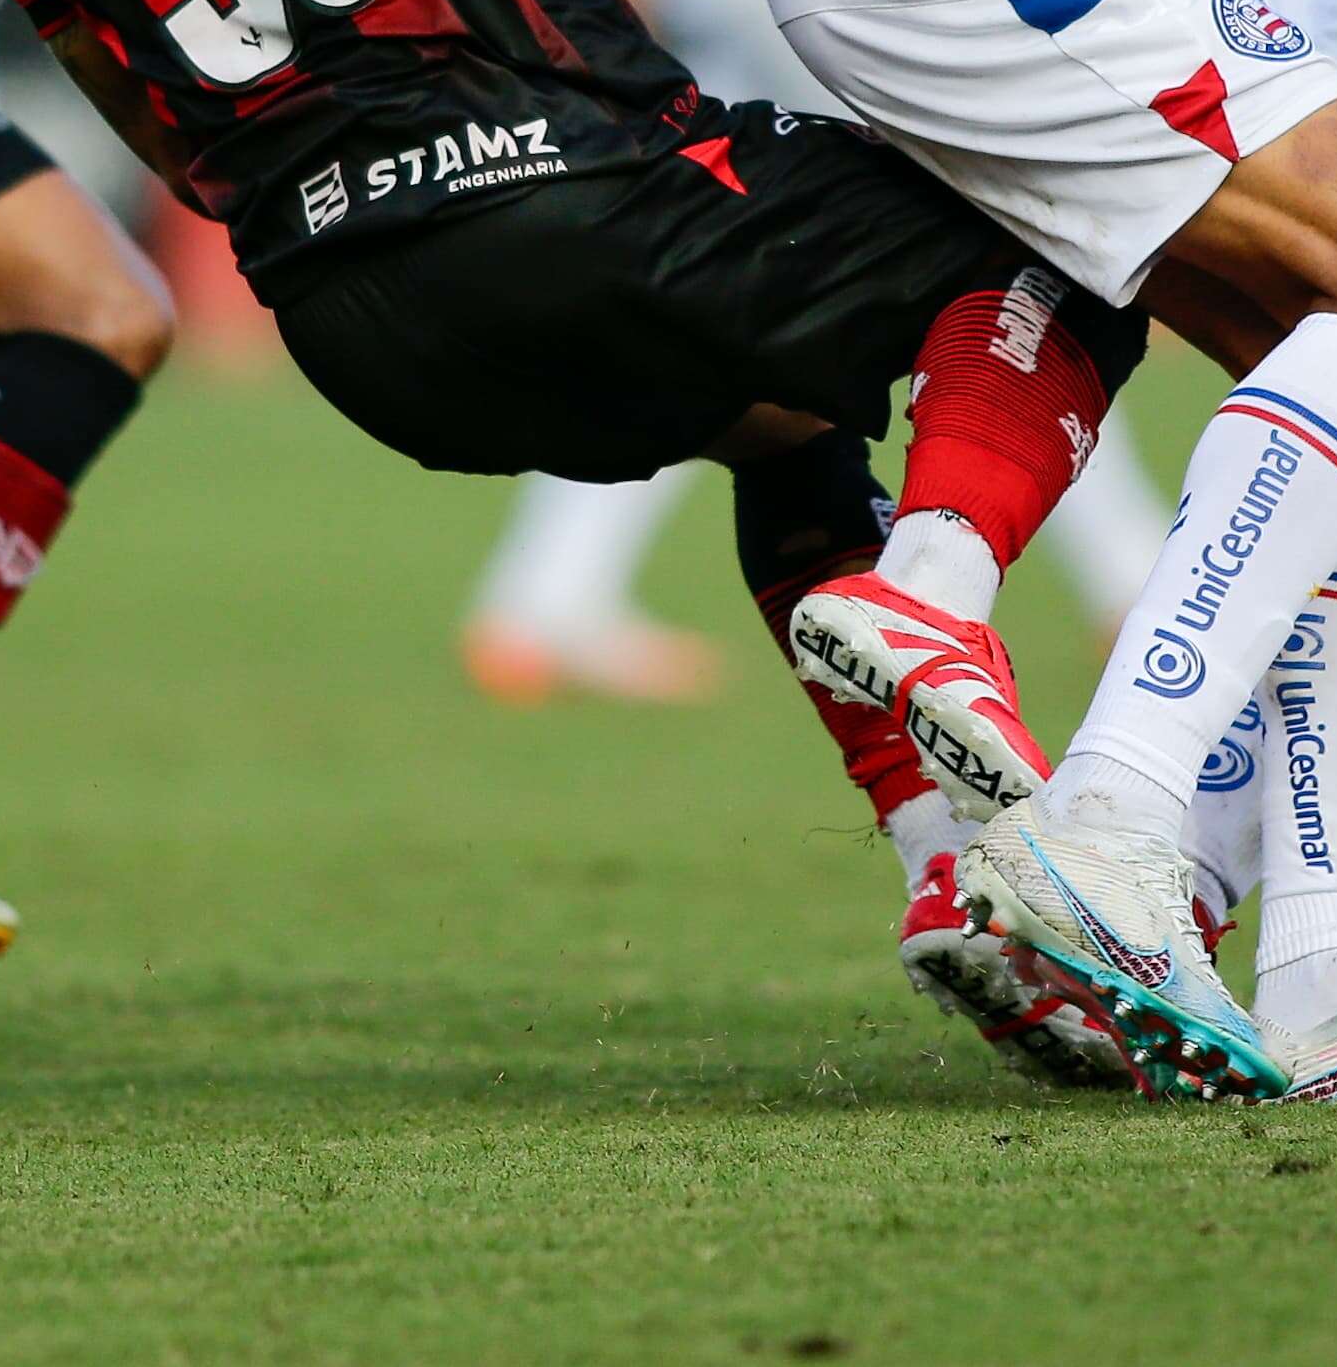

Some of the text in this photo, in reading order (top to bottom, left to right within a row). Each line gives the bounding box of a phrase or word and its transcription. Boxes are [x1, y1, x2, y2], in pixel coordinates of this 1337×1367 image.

[367, 118, 561, 201] STAMZ
[447, 159, 568, 194] ENGENHARIA
[1174, 428, 1303, 632] UniCesumar
[1275, 681, 1333, 874] UniCesumar
